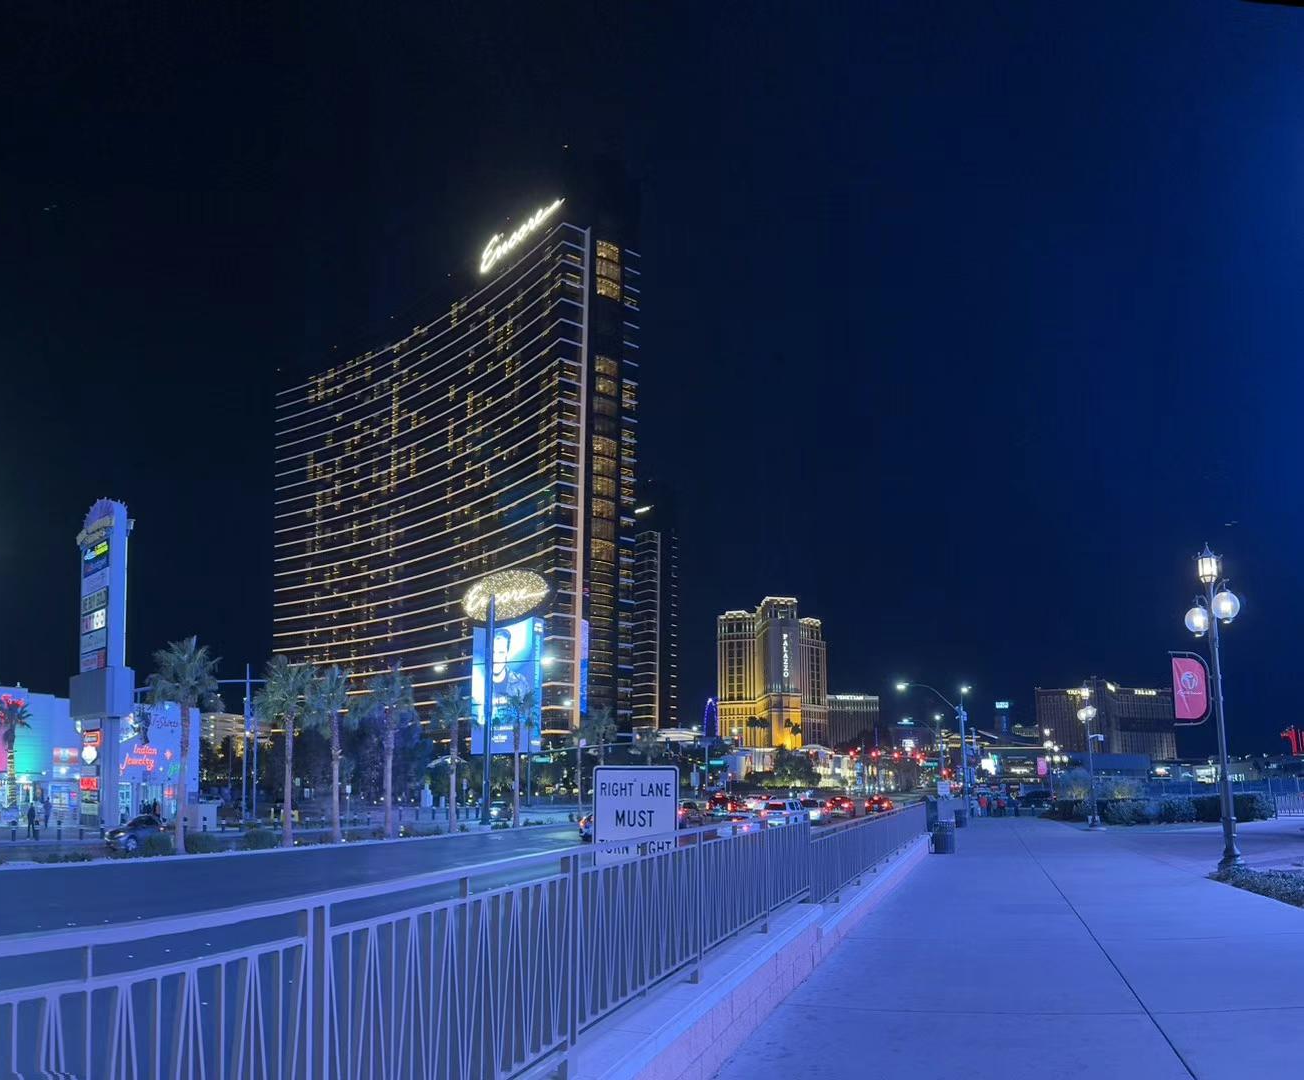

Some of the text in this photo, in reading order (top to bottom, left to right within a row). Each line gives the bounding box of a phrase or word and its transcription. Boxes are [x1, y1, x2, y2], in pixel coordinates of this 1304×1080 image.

[481, 198, 565, 273] Encore
[782, 633, 790, 678] PALAZZO
[133, 743, 158, 756] Indian
[600, 783, 671, 797] RIGHT LANE
[615, 810, 654, 827] MUST
